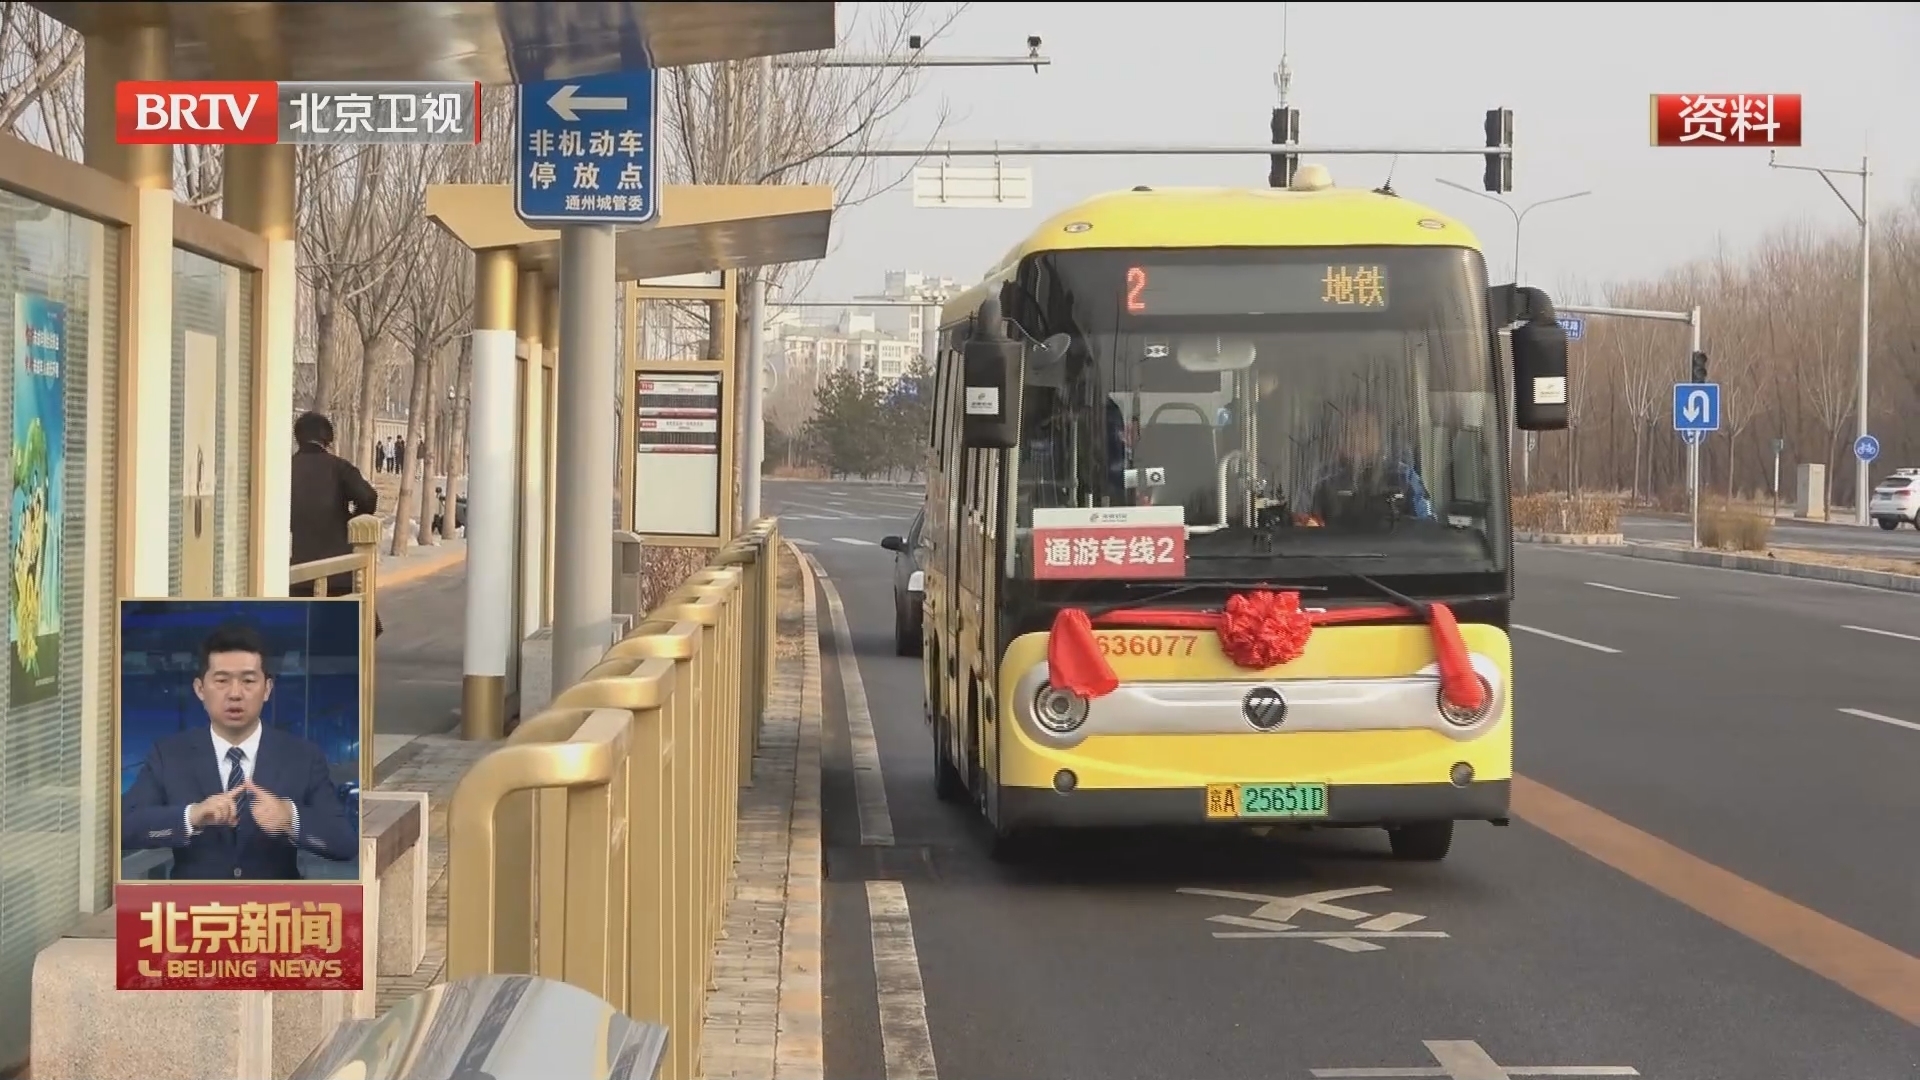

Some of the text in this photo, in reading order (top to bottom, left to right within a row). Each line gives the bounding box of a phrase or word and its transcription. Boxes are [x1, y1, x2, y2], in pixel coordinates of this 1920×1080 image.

[528, 129, 644, 158] 非机动车
[528, 161, 644, 190] 停放点
[565, 195, 644, 212] 通州城管委
[1126, 265, 1385, 310] 2 地铁
[1044, 535, 1176, 566] 通游专线2
